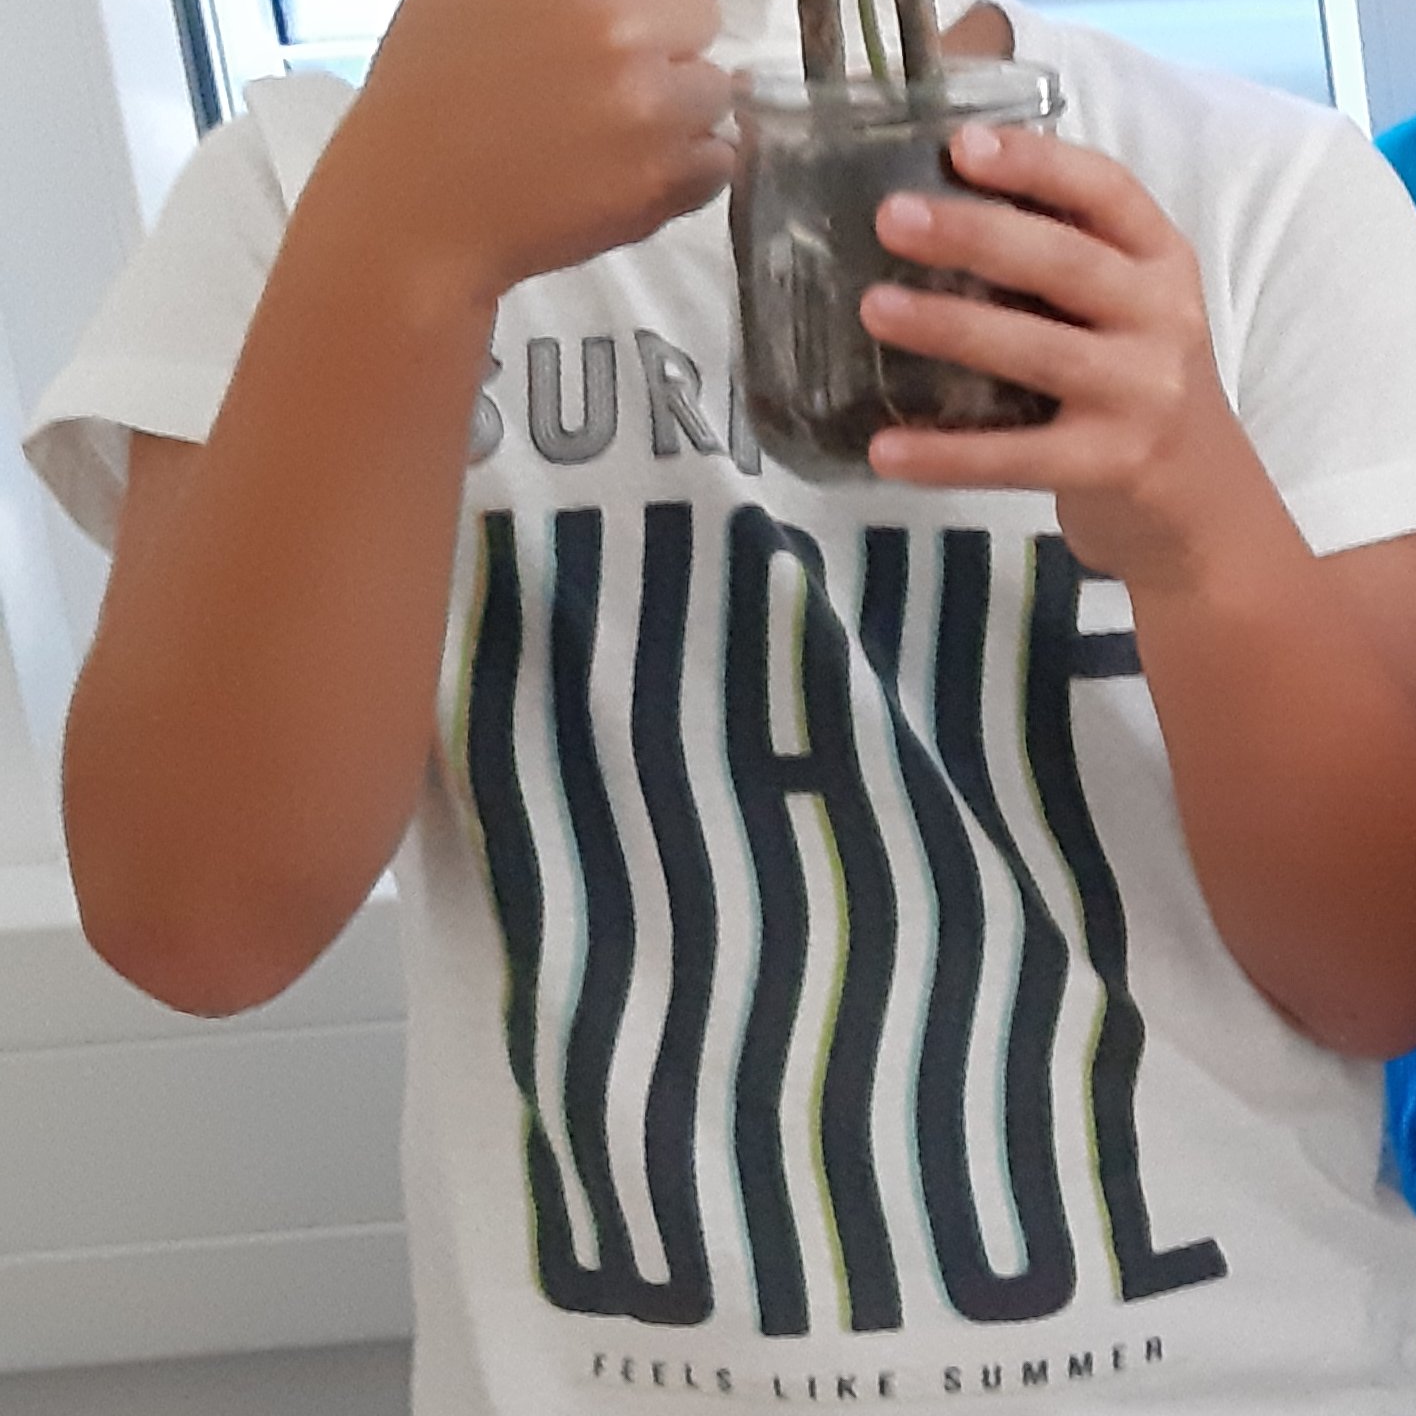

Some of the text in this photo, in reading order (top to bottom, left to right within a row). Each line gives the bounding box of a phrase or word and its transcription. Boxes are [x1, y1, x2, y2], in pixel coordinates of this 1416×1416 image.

[592, 1335, 1163, 1400] FEELS LIKE SUMMER
